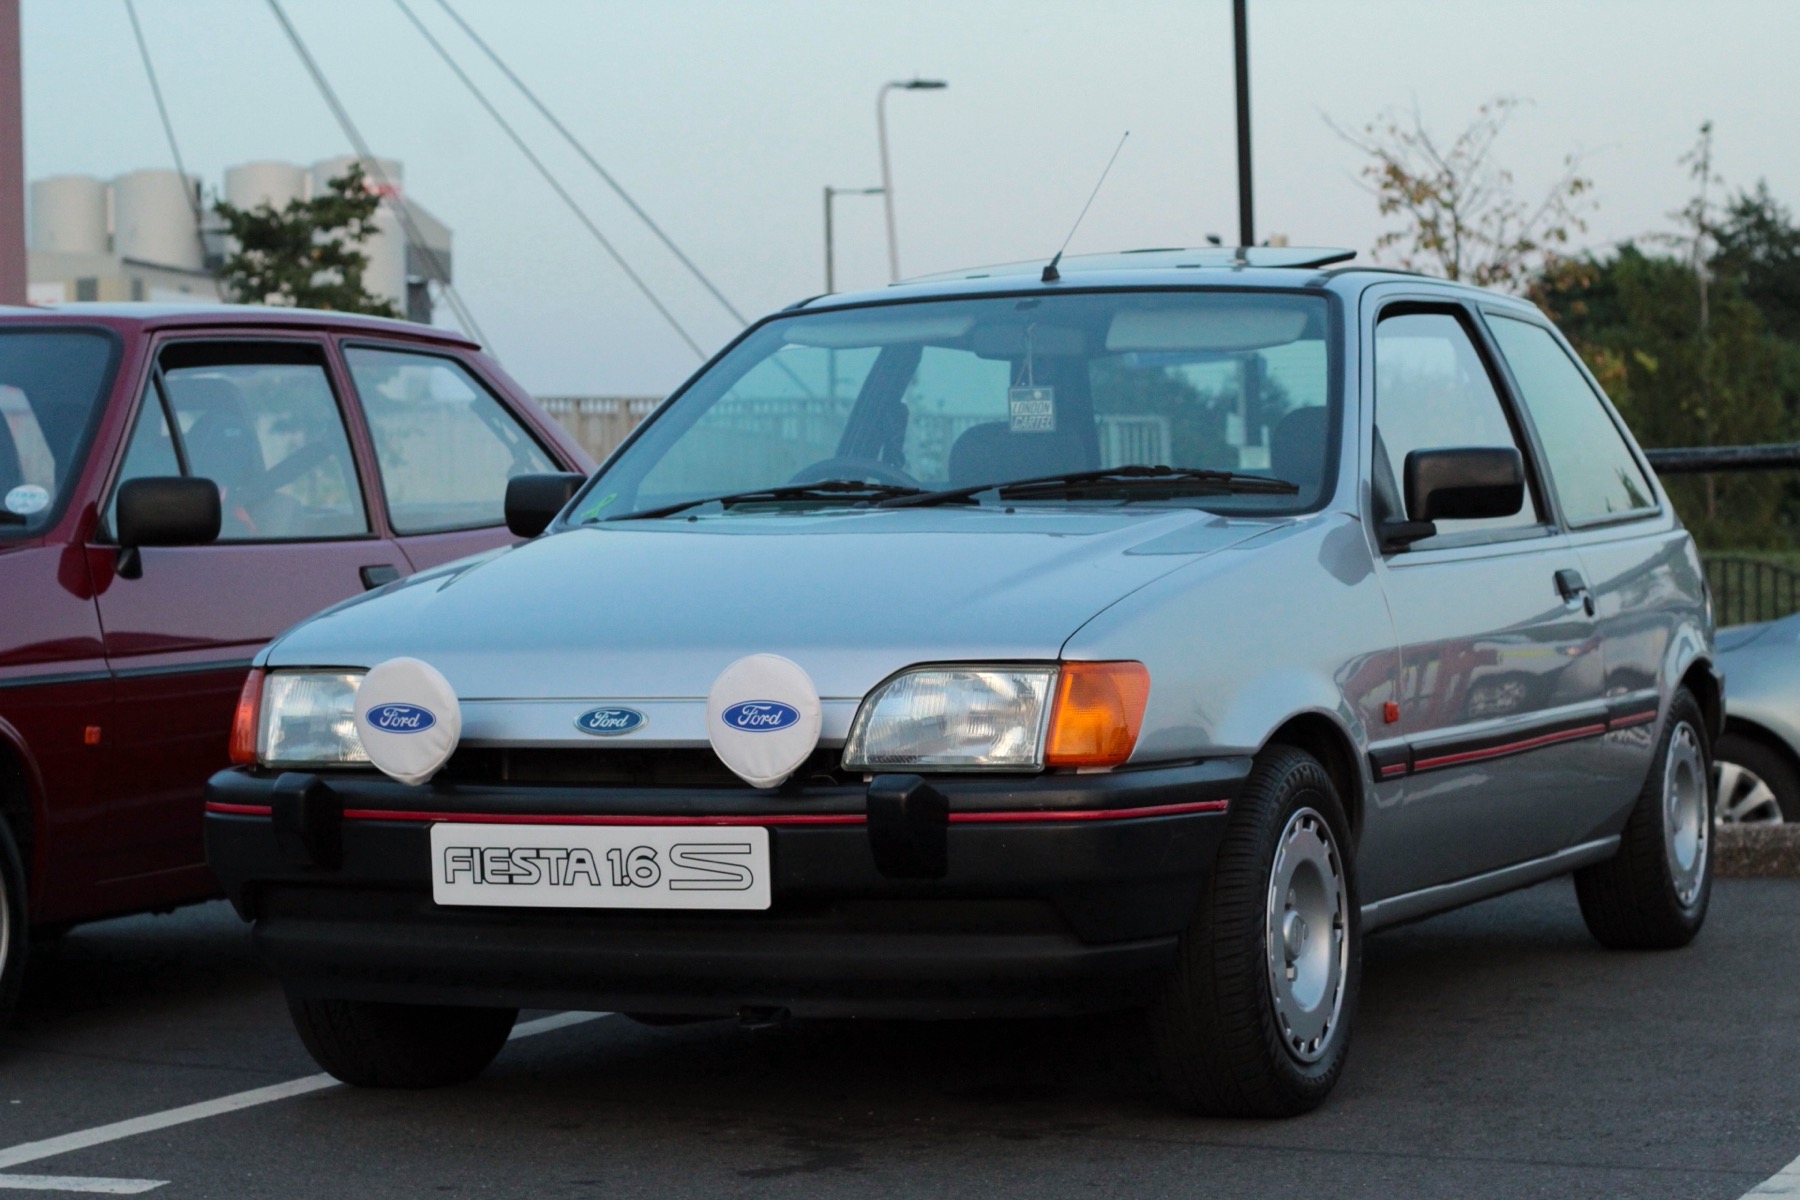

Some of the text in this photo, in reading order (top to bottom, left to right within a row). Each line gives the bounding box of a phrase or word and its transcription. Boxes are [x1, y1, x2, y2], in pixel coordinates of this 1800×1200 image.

[1012, 402, 1051, 414] LONDON
[379, 707, 421, 728] Ford
[589, 711, 631, 728] Ford
[737, 704, 784, 726] Ford
[444, 843, 754, 891] FIESTA 1.6 S
